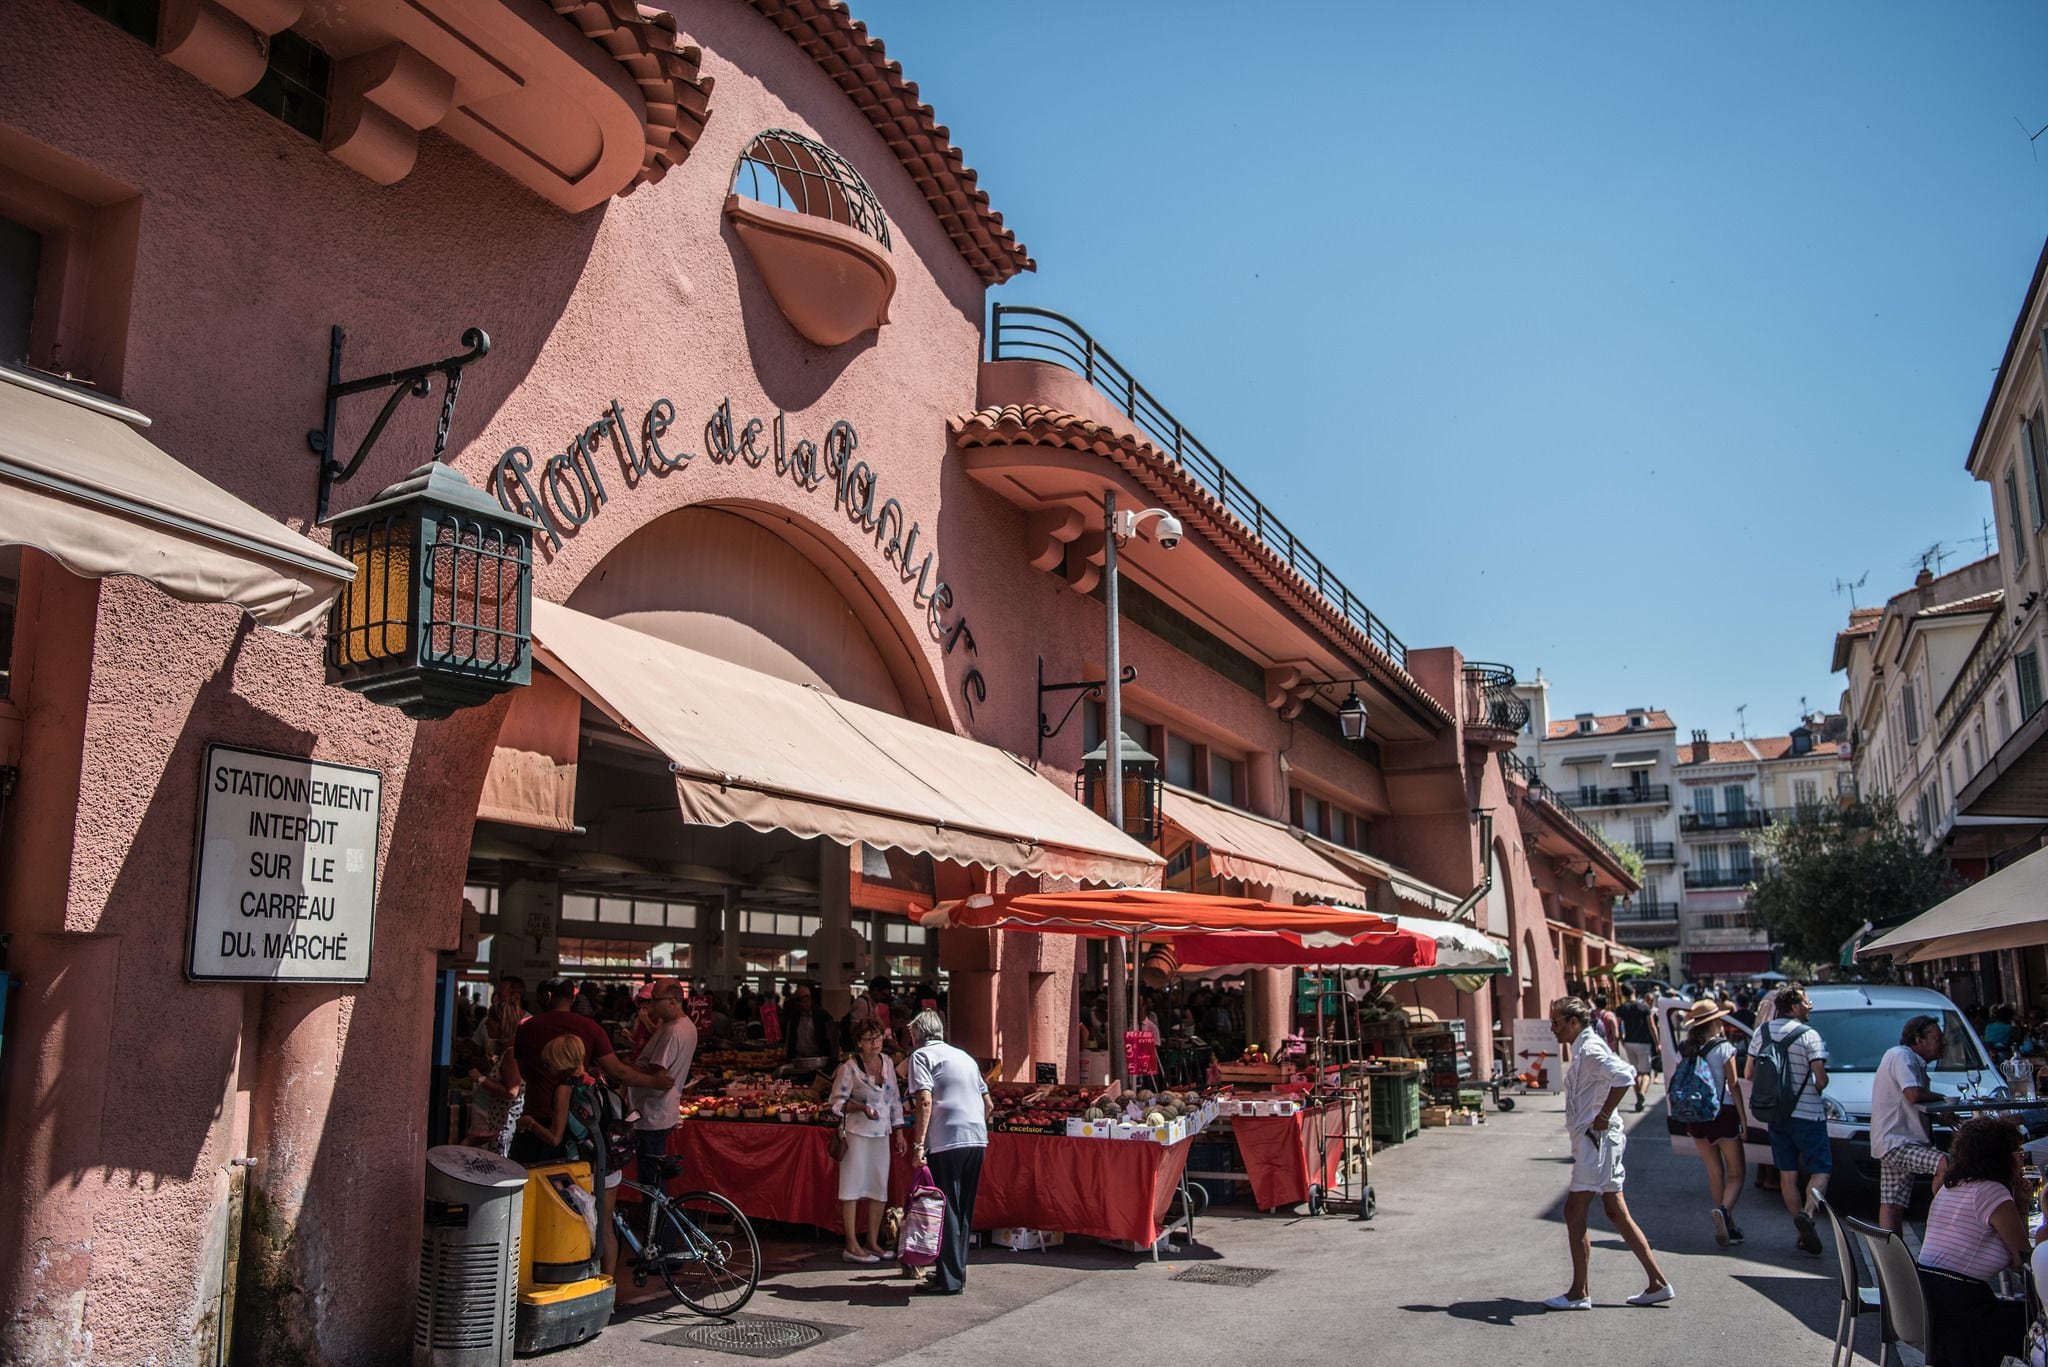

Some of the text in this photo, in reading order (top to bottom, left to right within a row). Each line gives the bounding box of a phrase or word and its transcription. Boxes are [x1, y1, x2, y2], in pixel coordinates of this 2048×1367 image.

[497, 397, 695, 552] Porte
[711, 396, 768, 460] de
[779, 409, 825, 483] la
[214, 767, 374, 812] STATIONNEMENT
[249, 811, 339, 845] INTERDIT
[250, 852, 335, 883] SUR LE
[240, 891, 335, 921] CARREAU
[263, 932, 348, 961] MARCHÉ
[1009, 1125, 1044, 1133] excelsior
